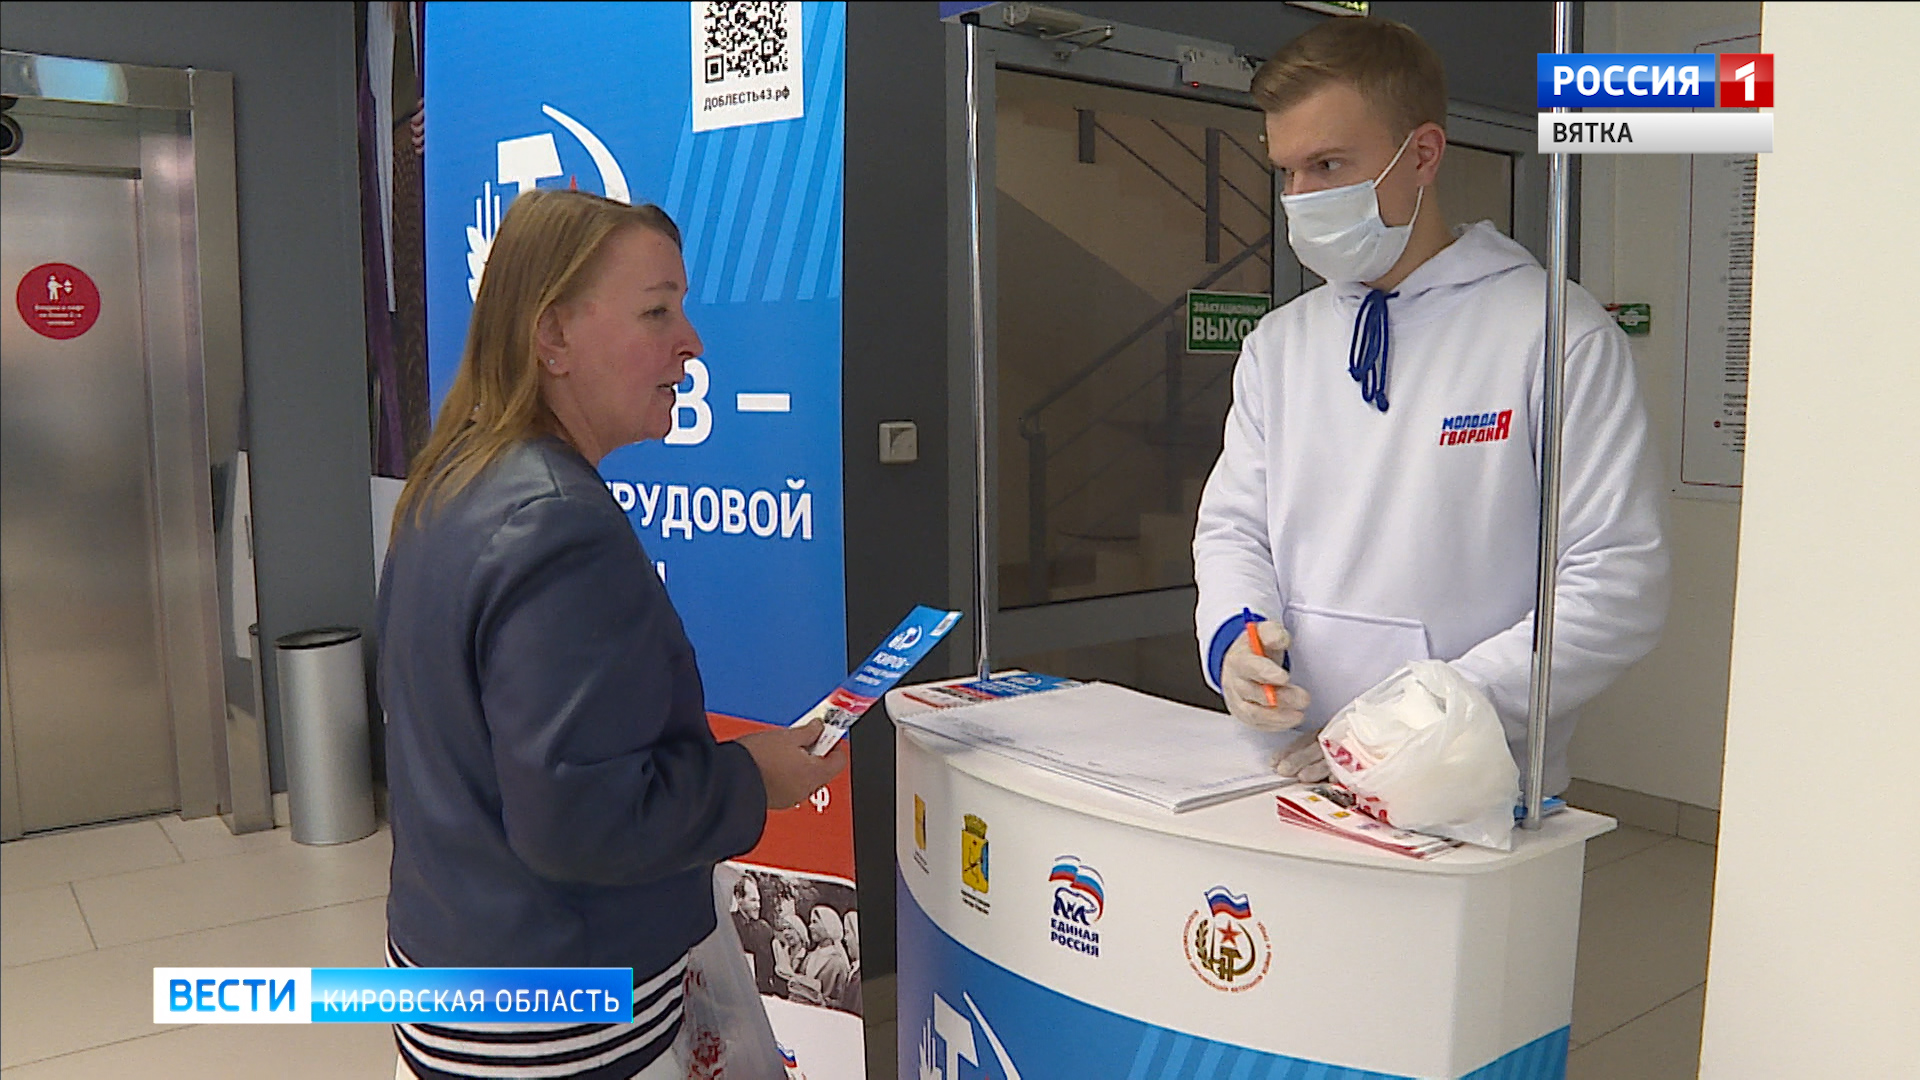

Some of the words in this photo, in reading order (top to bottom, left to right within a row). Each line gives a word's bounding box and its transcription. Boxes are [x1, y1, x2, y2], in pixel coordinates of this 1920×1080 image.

[703, 85, 790, 112] ДОБЛЕСТЬ43.рф
[1192, 316, 1260, 342] ВЫХО
[605, 478, 813, 540] РУДОВОЙ
[1050, 917, 1099, 944] ЕДИНАЯ
[1050, 931, 1099, 957] РОССИЯ
